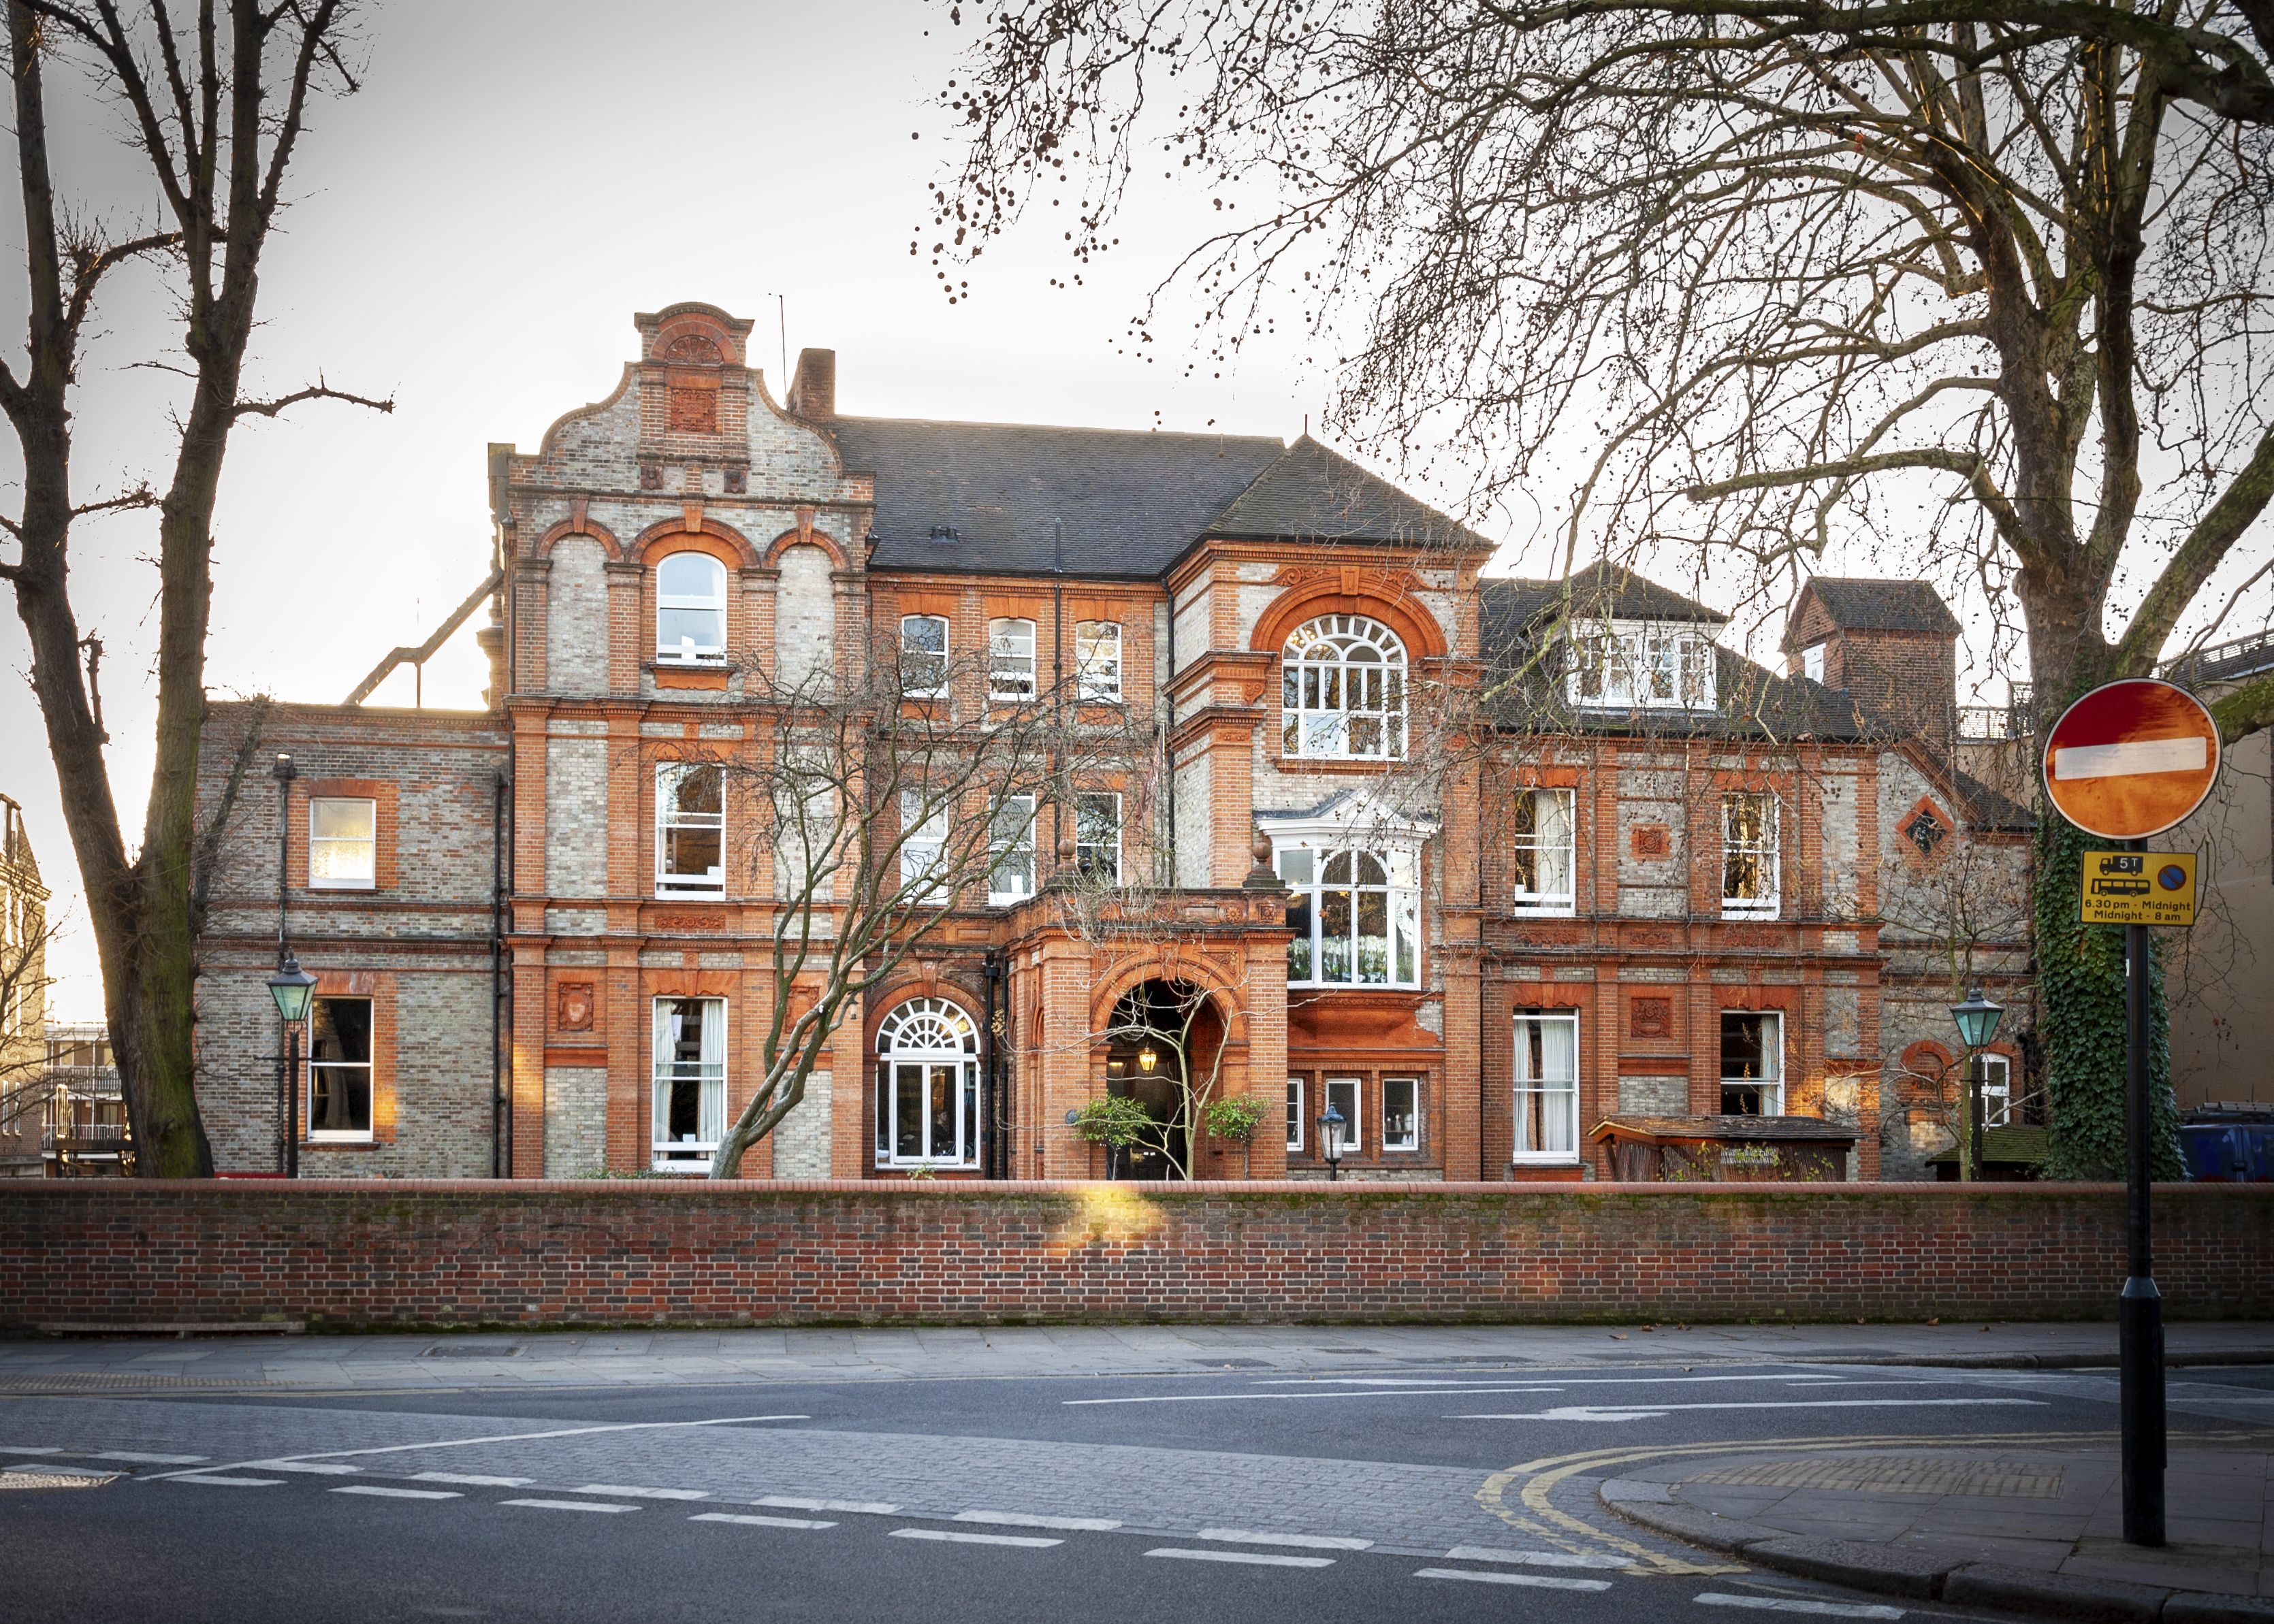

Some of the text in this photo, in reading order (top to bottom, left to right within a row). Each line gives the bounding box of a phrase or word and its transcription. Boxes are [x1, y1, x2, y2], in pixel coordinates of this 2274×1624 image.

[2085, 899, 2111, 909] 6.30
[2113, 902, 2130, 910] pm
[2141, 900, 2191, 912] Midnight
[2094, 909, 2143, 921] Midnight
[2154, 911, 2162, 921] 8
[2164, 913, 2181, 922] am
